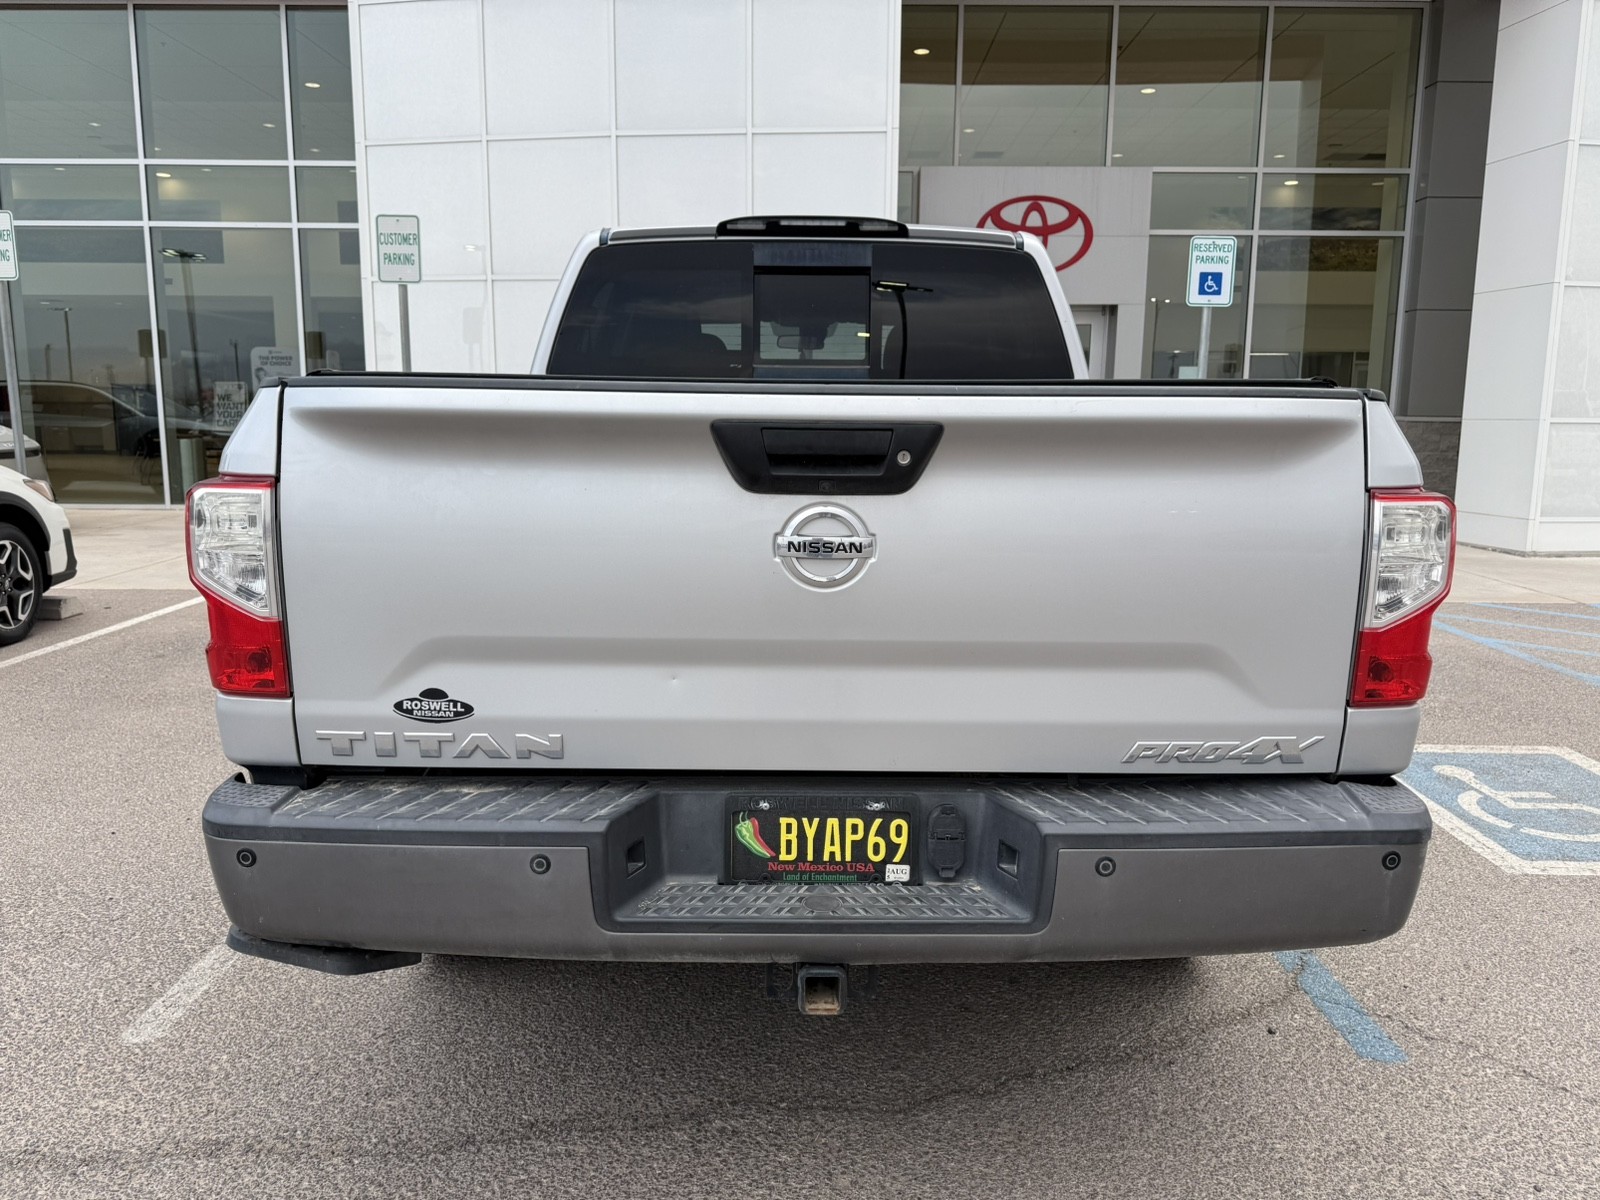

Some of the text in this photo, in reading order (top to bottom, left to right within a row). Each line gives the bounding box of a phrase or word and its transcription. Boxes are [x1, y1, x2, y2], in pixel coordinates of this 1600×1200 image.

[379, 233, 418, 245] CUSTOMER
[1194, 243, 1232, 253] RESERVED
[383, 253, 415, 266] PARKING
[1195, 255, 1229, 265] PARKING
[217, 393, 233, 402] WE
[217, 402, 244, 411] WANT
[217, 411, 243, 419] YOUR
[787, 541, 863, 554] NISSAN
[402, 700, 465, 712] ROSWELL
[413, 710, 454, 718] NISSAN
[316, 730, 565, 760] TITAN
[778, 816, 909, 863] BYAP69
[767, 862, 875, 872] New Mexico USA
[783, 872, 858, 881] Land of Enchantment
